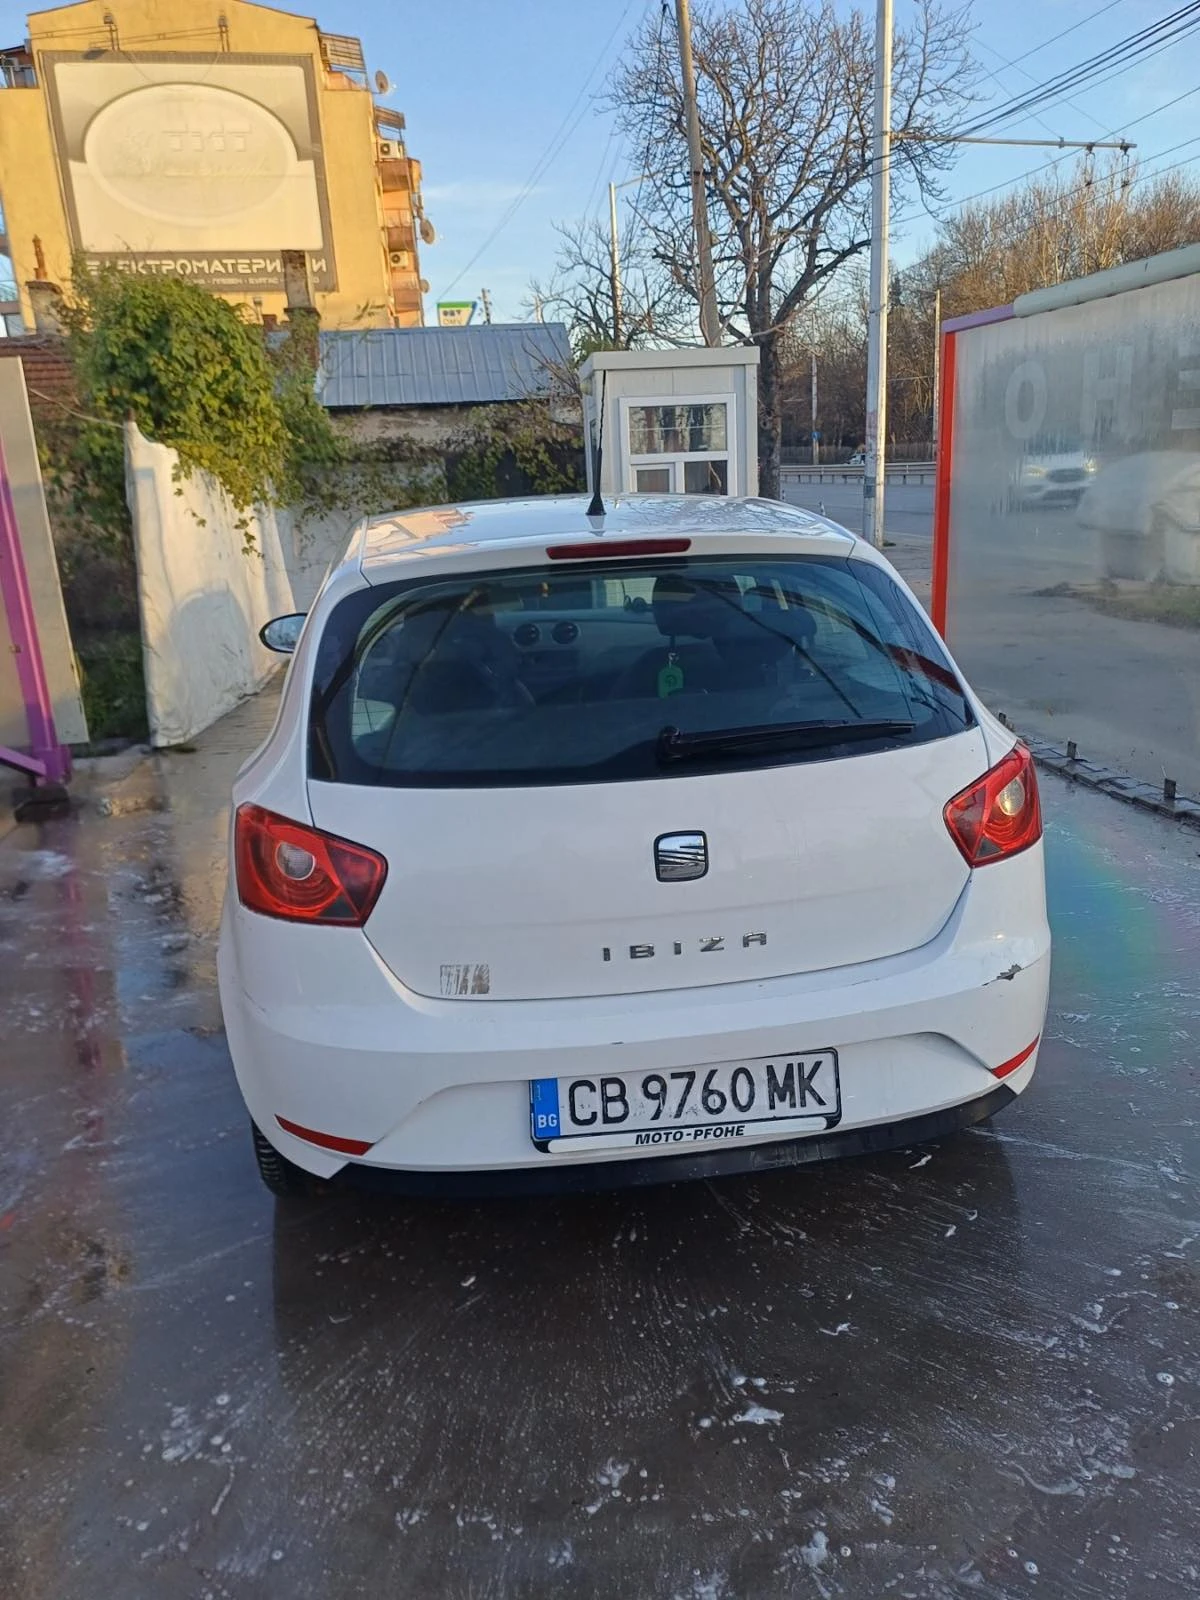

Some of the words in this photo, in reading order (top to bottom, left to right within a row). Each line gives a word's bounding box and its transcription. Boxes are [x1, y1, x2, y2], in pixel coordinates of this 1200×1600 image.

[602, 931, 768, 962] IBIZA
[568, 1076, 630, 1126] CB
[641, 1067, 755, 1120] 9760
[766, 1060, 827, 1110] MK
[537, 1113, 558, 1129] BG
[635, 1125, 745, 1145] MOTO-PFOHE
